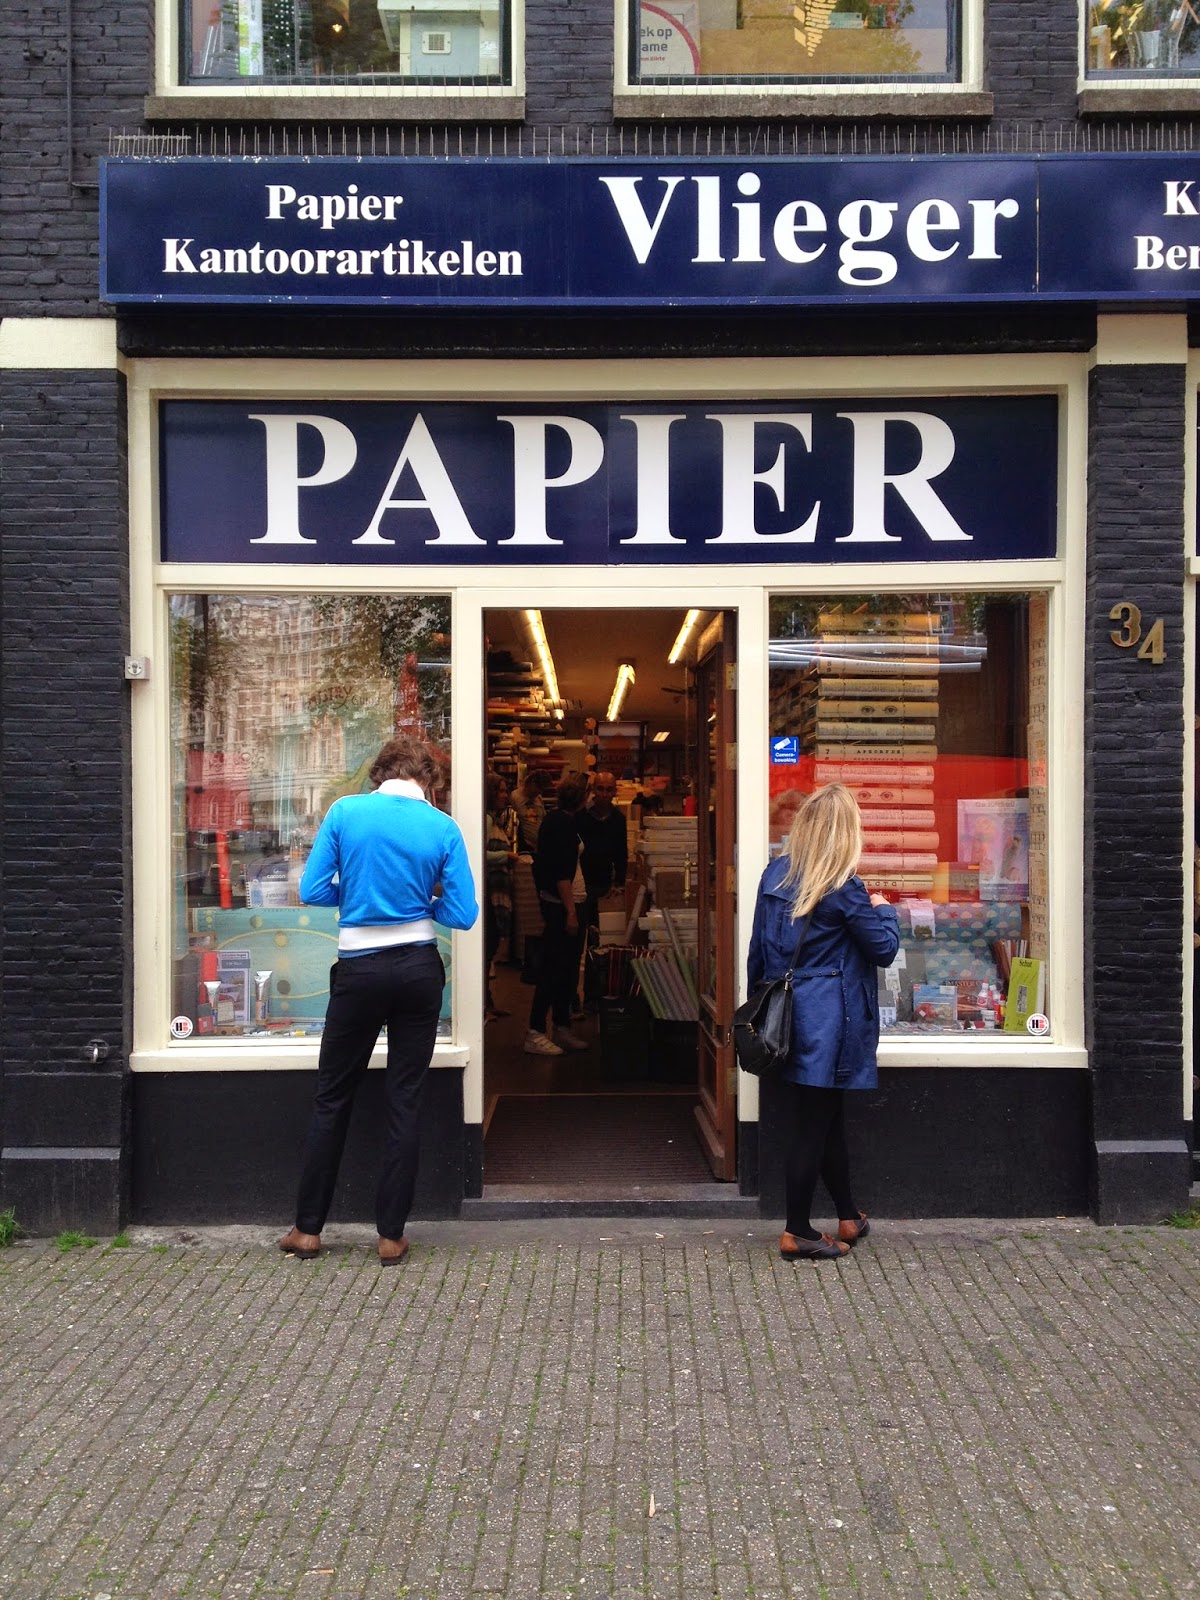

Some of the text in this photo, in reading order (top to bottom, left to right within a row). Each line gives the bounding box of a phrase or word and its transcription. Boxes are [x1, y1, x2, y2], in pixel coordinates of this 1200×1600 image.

[640, 27, 672, 39] ek op
[641, 43, 668, 52] ame
[265, 183, 404, 230] Papier
[1162, 180, 1200, 216] K
[598, 171, 1020, 287] Vlieger
[162, 238, 523, 276] Kantoorartikelen
[248, 411, 974, 546] PAPIER
[1109, 602, 1167, 665] 34
